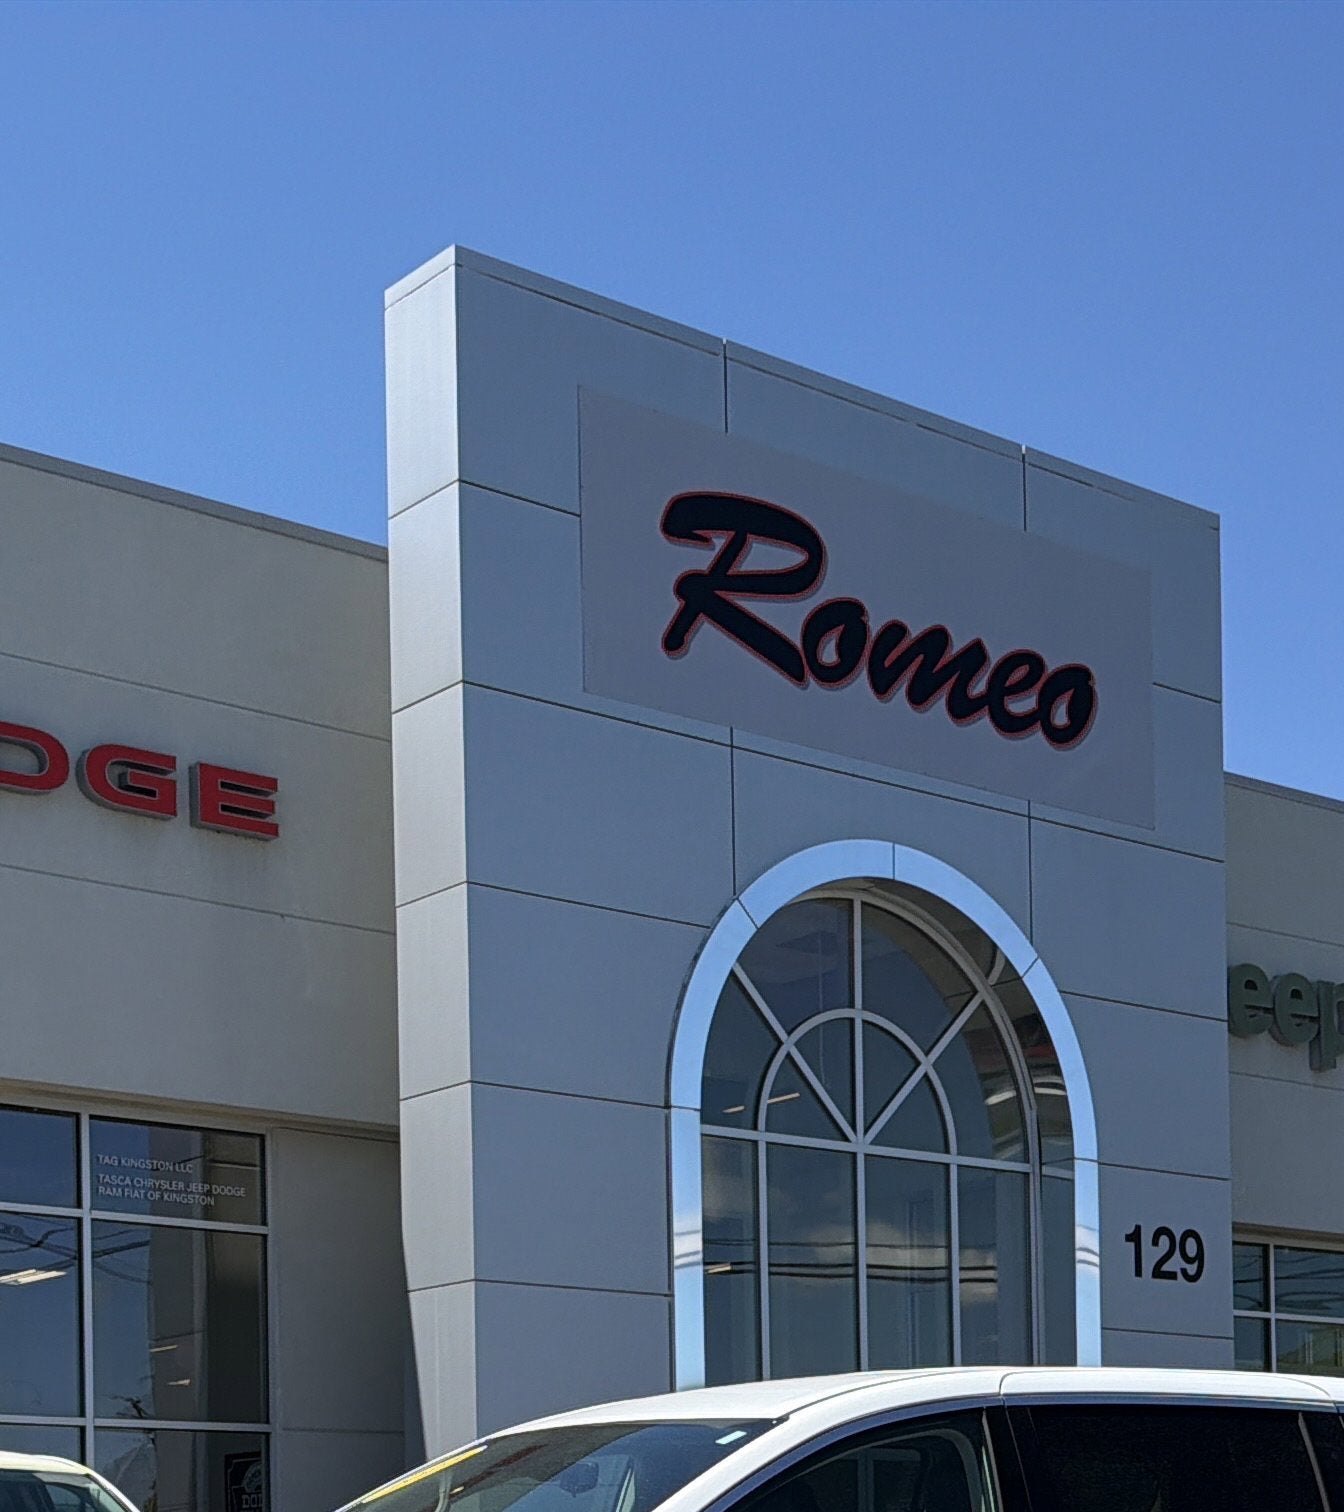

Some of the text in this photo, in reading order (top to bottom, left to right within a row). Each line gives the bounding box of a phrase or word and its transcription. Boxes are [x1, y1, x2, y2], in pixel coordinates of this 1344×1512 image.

[660, 491, 1097, 750] Romeo
[97, 1154, 193, 1174] TAG KINGSTON LLC
[98, 1174, 247, 1197] TASCA CHRYSLER JEEP DODGE
[98, 1186, 215, 1206] RAM FIAT OF KINGSTON
[1125, 1224, 1205, 1283] 129
